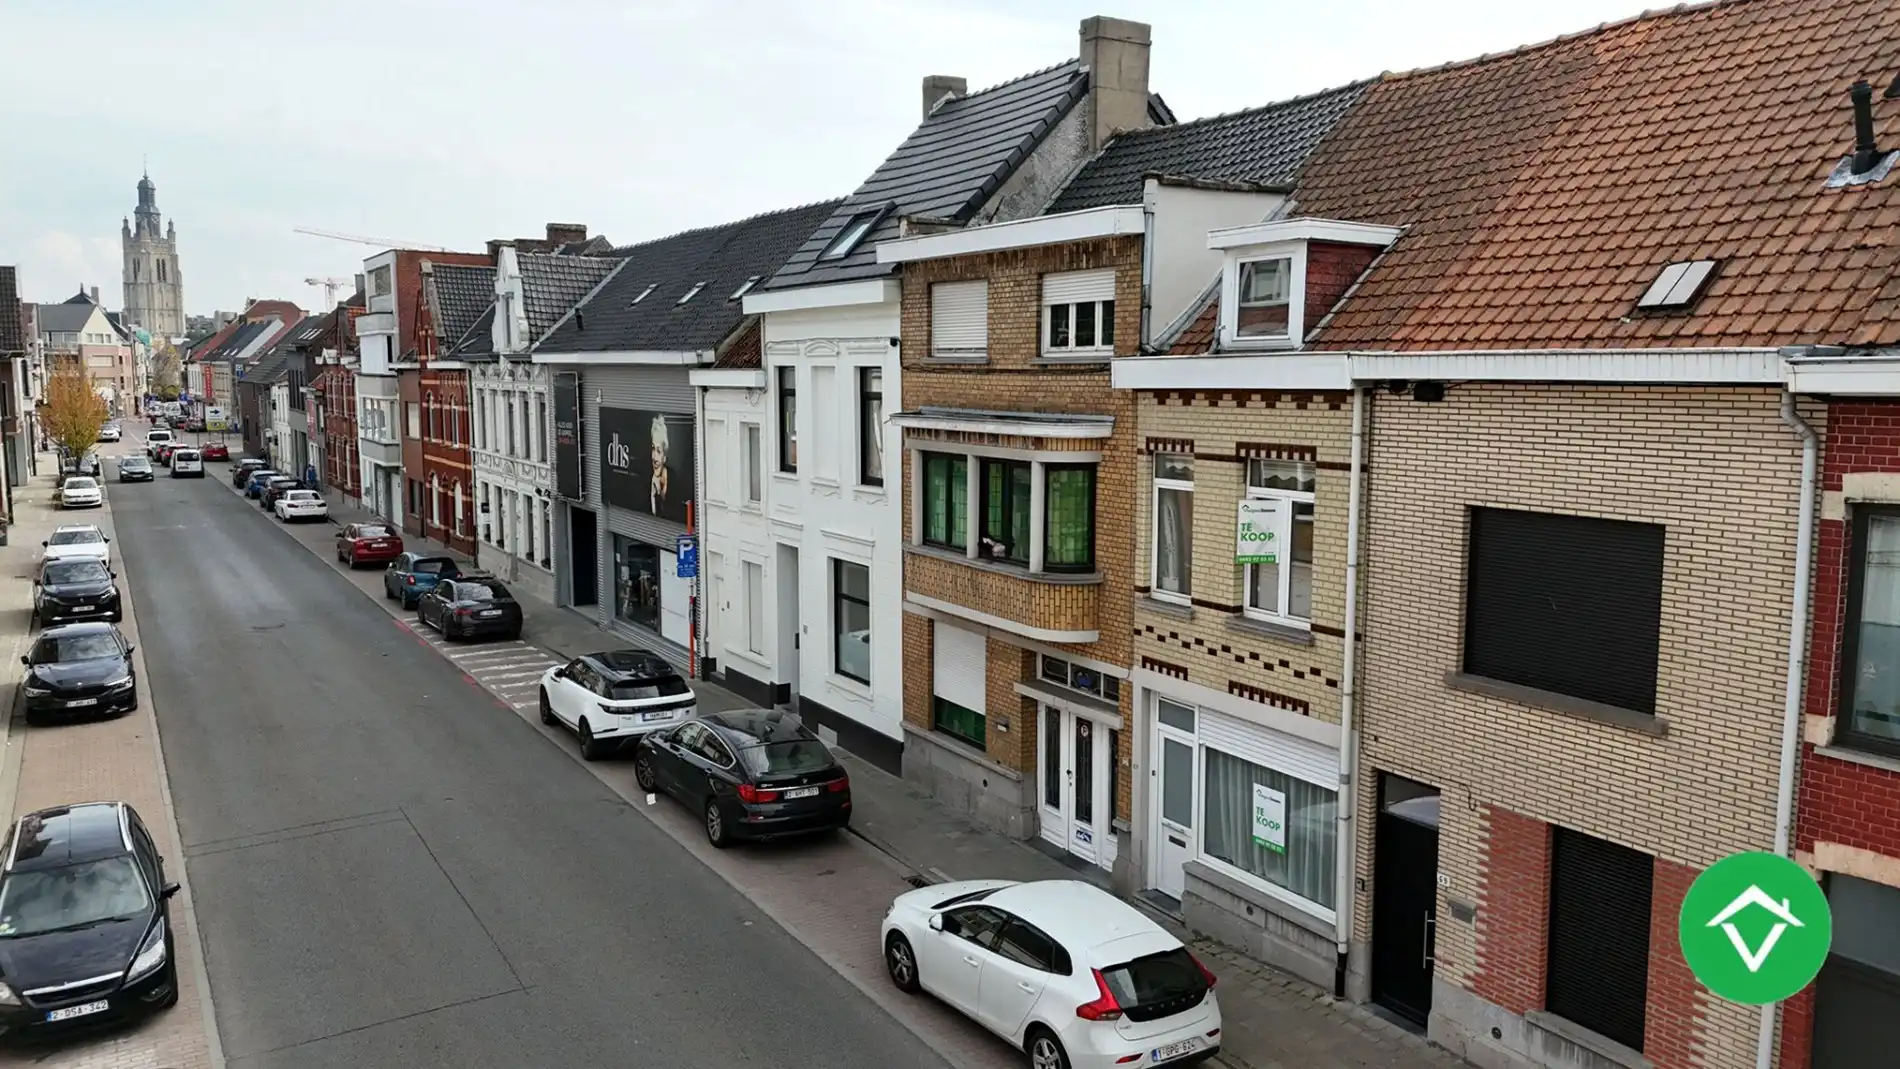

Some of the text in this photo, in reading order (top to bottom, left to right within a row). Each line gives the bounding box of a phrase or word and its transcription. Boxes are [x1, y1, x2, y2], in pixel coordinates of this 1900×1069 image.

[608, 432, 629, 468] dhs
[1240, 522, 1252, 532] TE
[1240, 532, 1275, 541] KOOP
[679, 539, 693, 560] P
[1256, 805, 1265, 817] TE
[1256, 815, 1281, 832] KOOP
